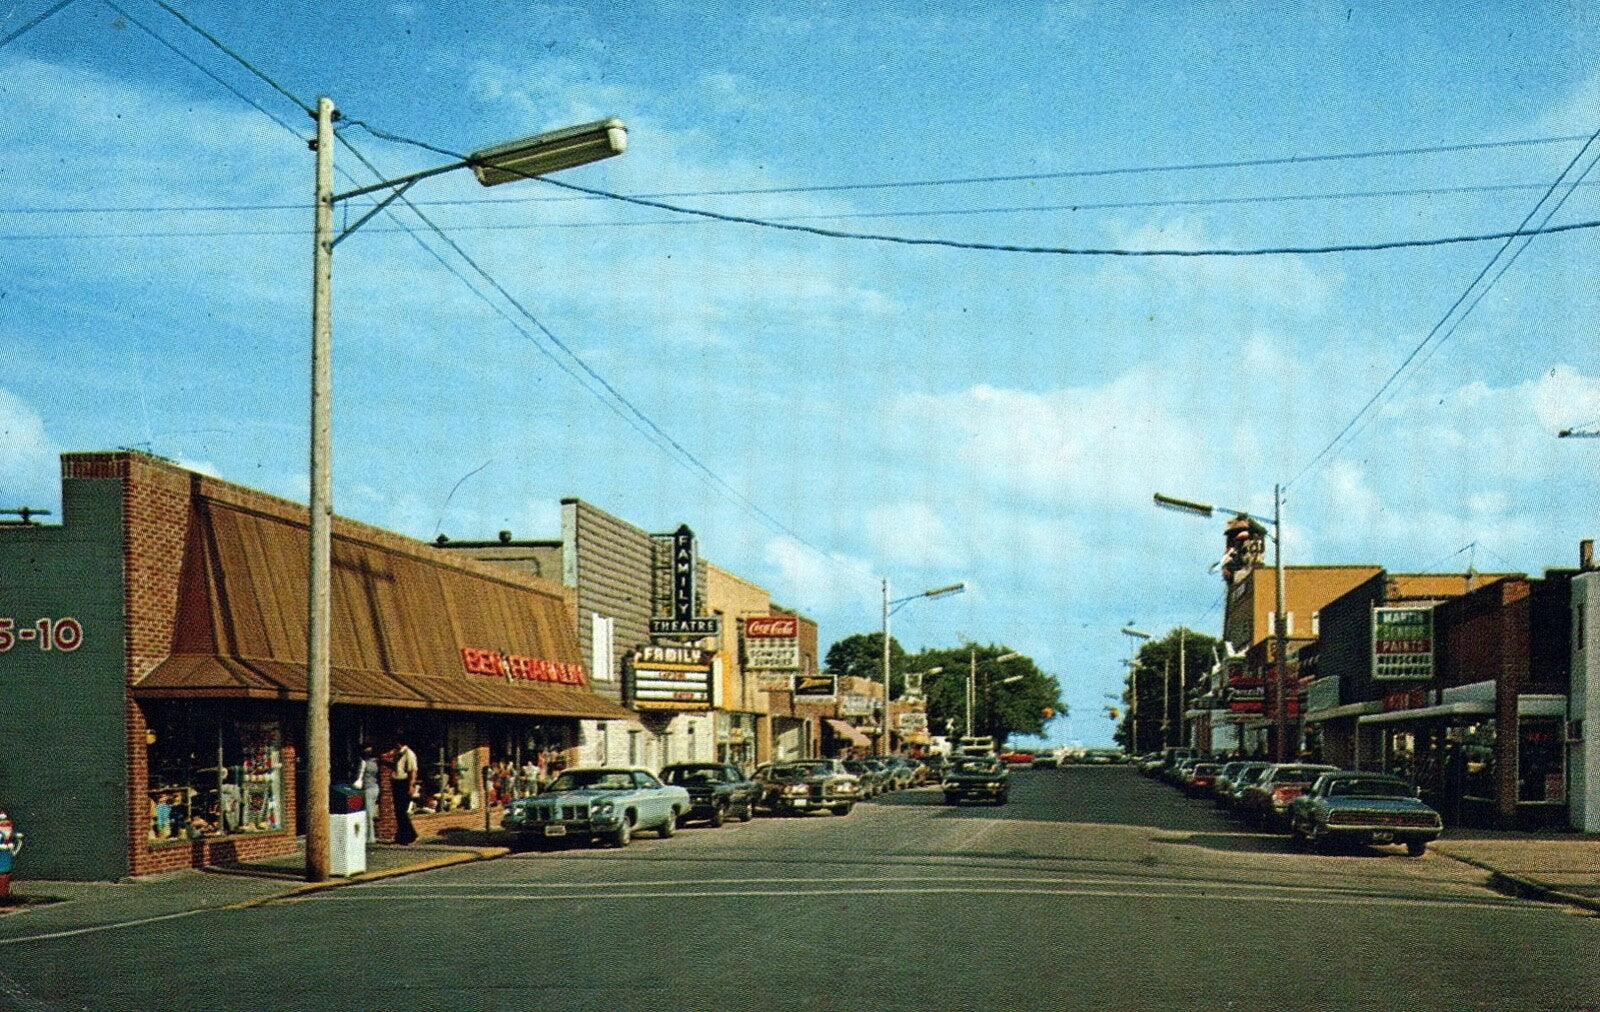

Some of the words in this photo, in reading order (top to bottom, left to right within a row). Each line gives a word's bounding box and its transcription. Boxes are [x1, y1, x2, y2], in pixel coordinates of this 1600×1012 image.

[677, 535, 690, 615] FAMILY
[654, 621, 714, 631] THEATRE
[1383, 641, 1424, 651] PAINTS
[644, 647, 701, 662] FAMILY
